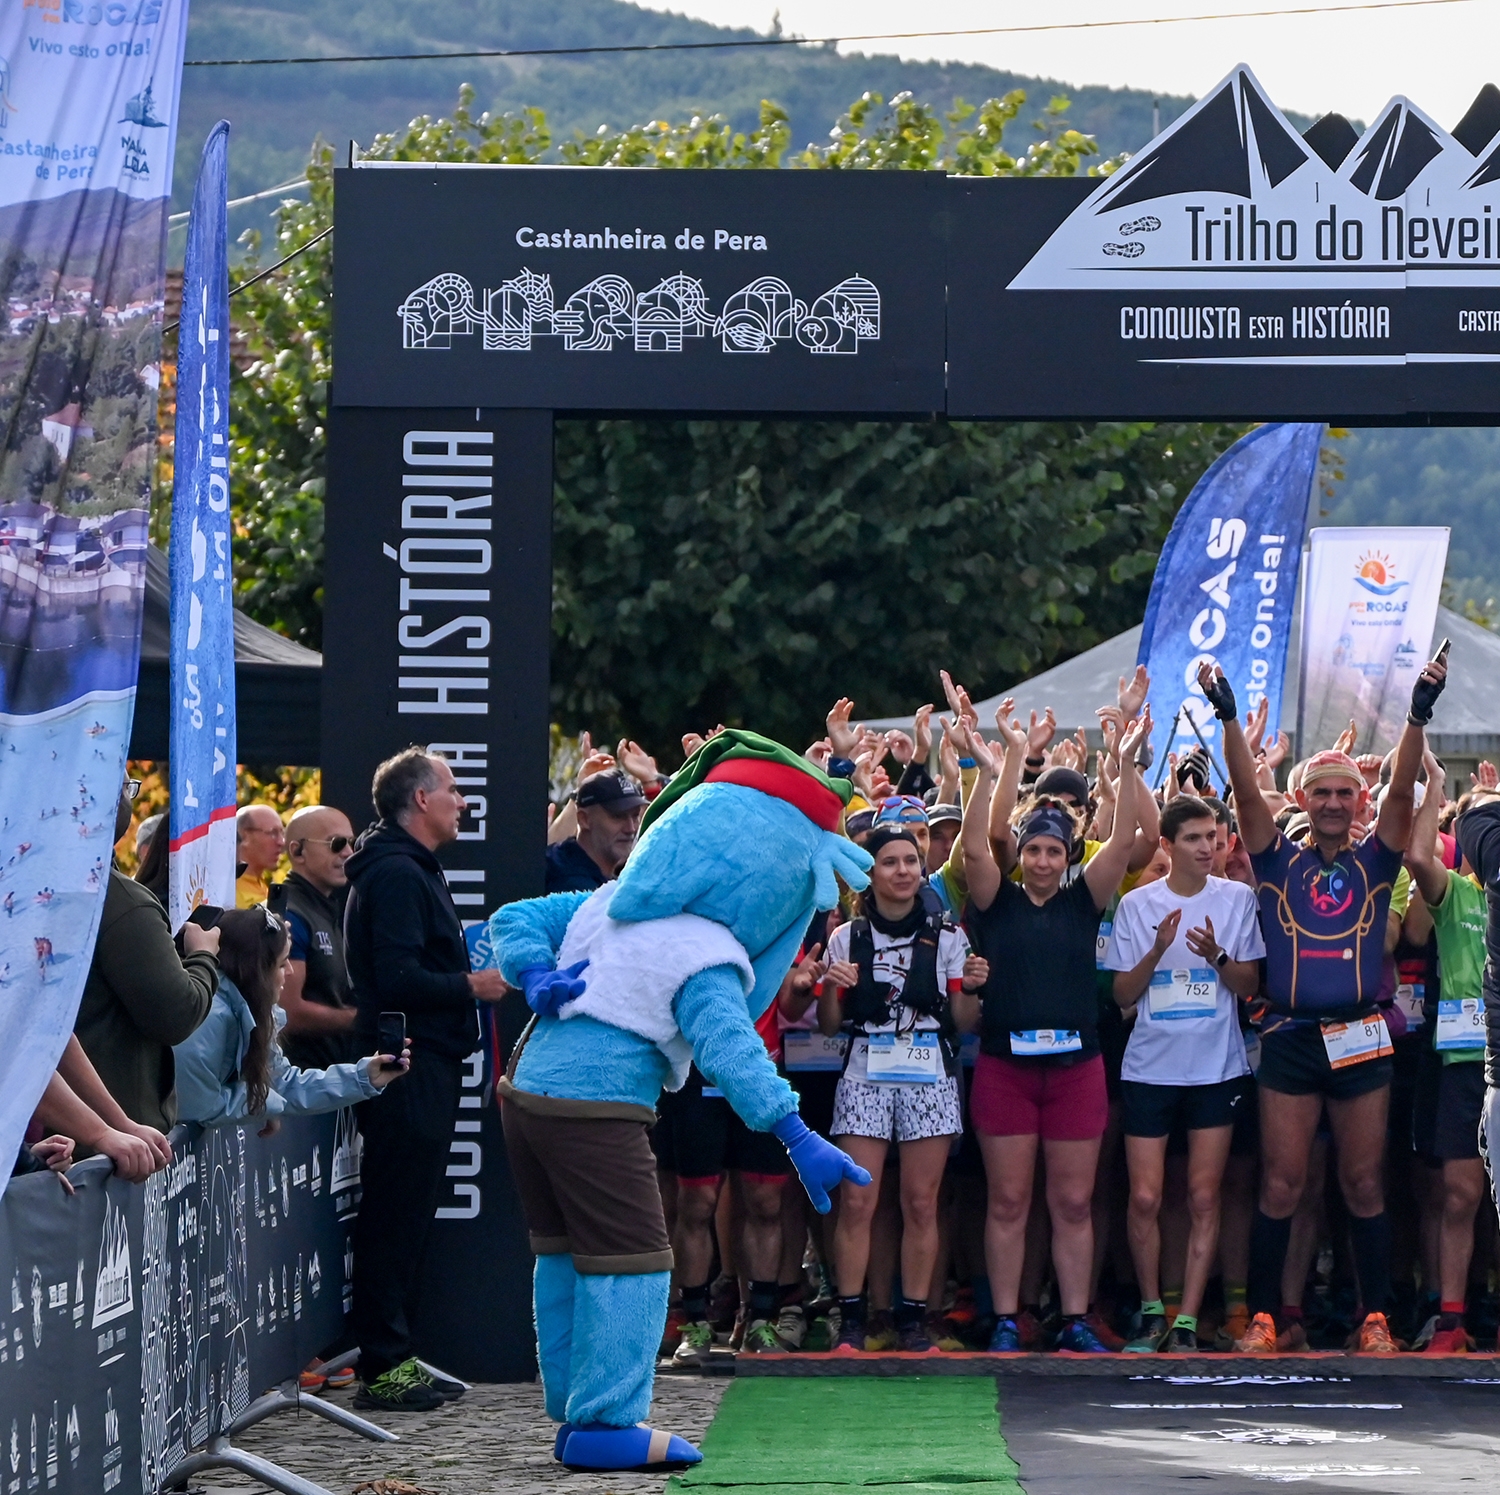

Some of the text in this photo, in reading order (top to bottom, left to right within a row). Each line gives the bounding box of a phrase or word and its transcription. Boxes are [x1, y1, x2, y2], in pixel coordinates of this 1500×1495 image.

[35, 161, 50, 180] de
[515, 226, 768, 253] Castanheira de Pera
[1185, 204, 1297, 263] Trilho
[1315, 204, 1363, 262] do
[1120, 299, 1391, 341] CONQUISTA ESTA HISTÓRIA
[383, 430, 494, 714] HISTÓRIA
[1250, 534, 1286, 649] onda!
[1366, 601, 1409, 613] ROCAS
[1184, 983, 1210, 996] 752
[906, 1047, 931, 1061] 733
